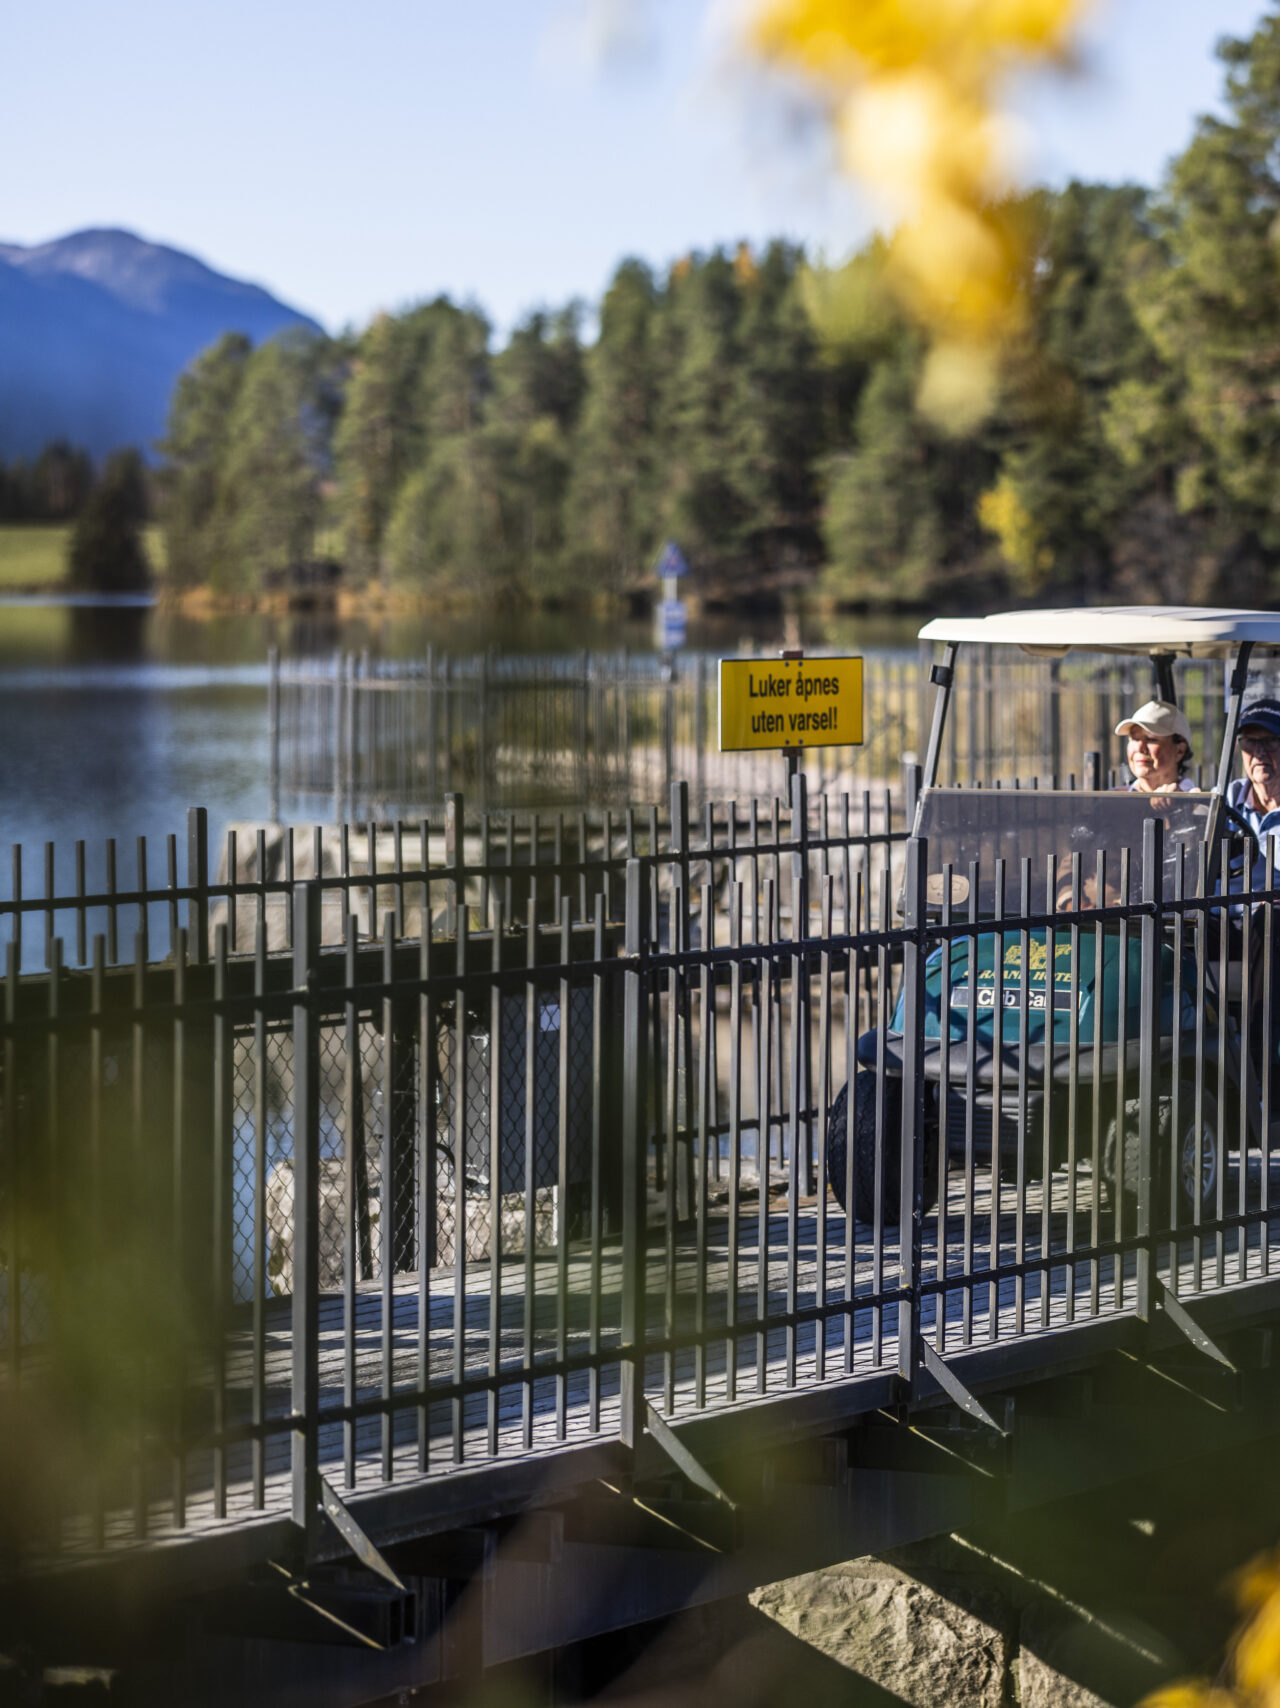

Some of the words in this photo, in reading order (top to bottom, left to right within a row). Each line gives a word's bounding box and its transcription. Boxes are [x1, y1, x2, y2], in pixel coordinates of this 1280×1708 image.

[749, 674, 792, 698] Luker
[795, 671, 839, 702] åpnes
[751, 711, 784, 733] uten
[788, 707, 838, 731] varsel!
[1032, 971, 1082, 983] HTE
[978, 989, 1016, 1006] Clb
